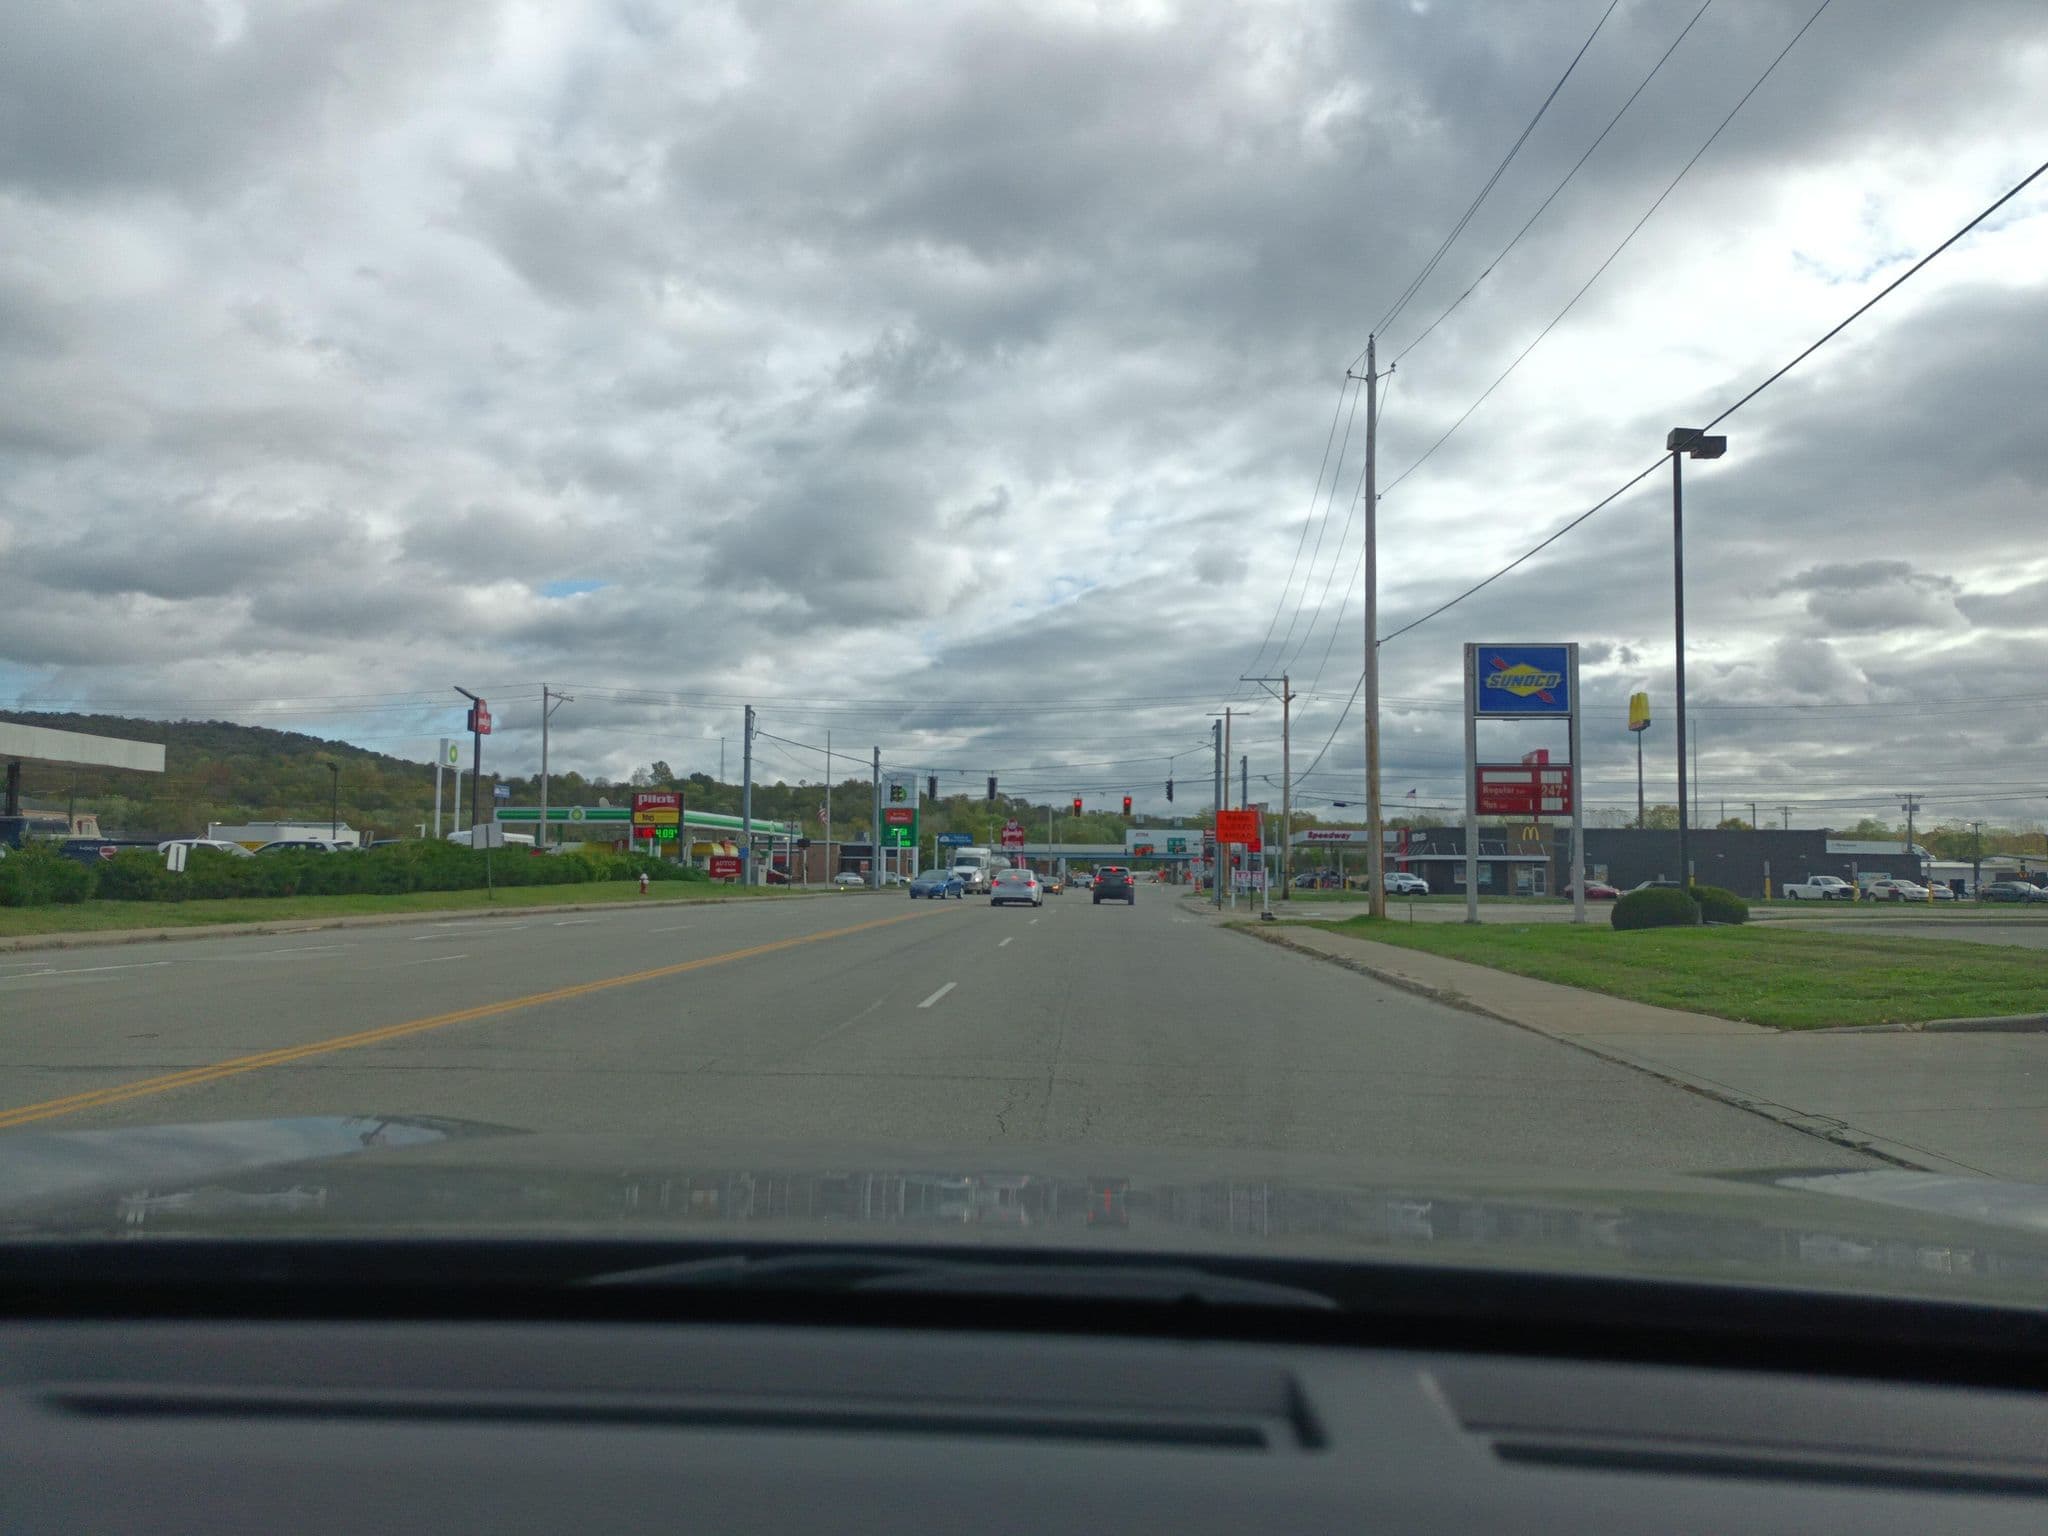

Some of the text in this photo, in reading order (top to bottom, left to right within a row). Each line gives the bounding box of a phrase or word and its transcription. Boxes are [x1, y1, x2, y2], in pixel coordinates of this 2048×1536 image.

[1487, 673, 1560, 688] SUNOCO
[1482, 784, 1514, 796] Regular
[1307, 831, 1351, 840] Speedway
